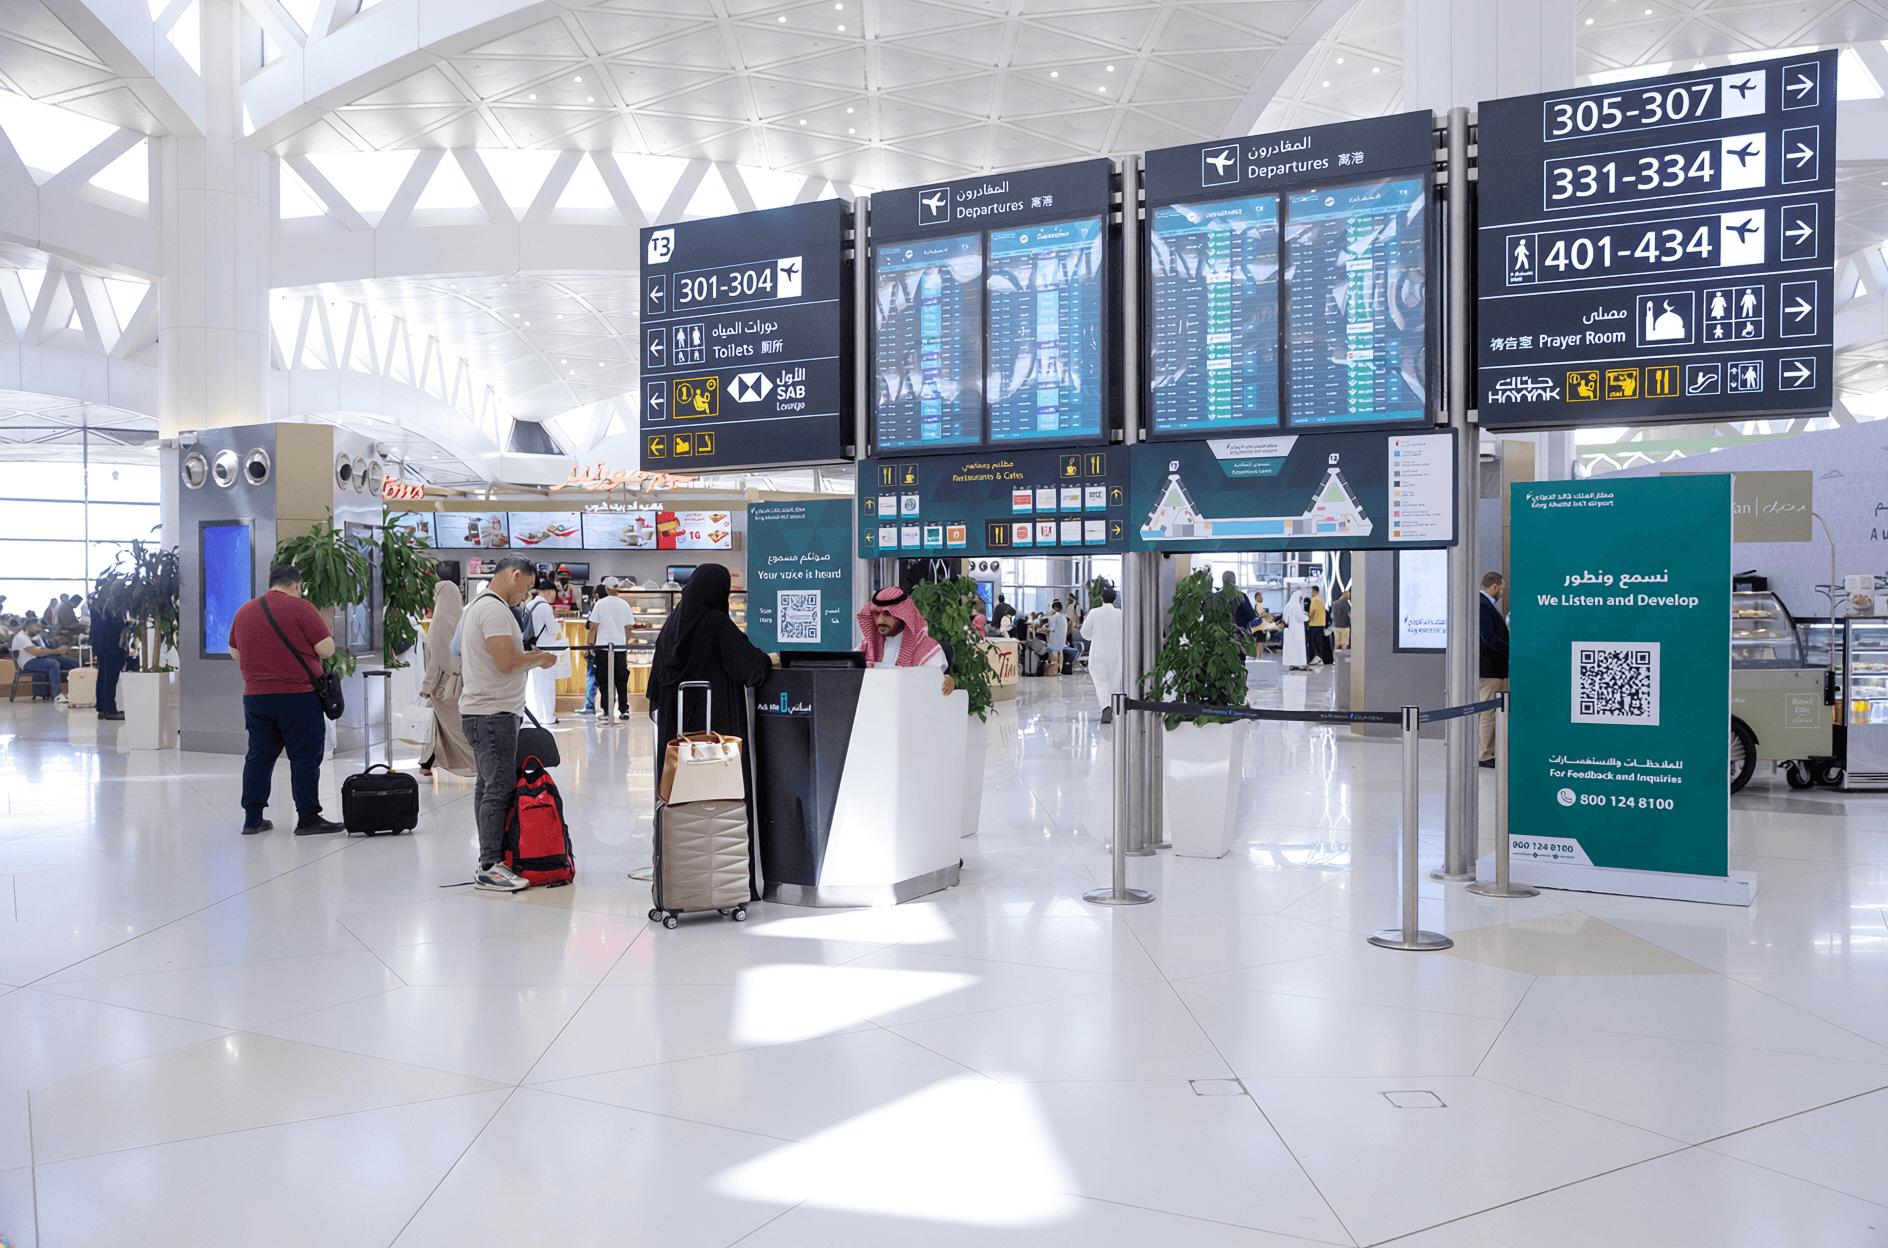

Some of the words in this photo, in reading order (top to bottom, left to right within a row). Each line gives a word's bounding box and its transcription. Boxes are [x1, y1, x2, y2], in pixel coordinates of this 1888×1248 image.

[1552, 84, 1713, 135] 305-307
[1248, 158, 1329, 178] Departures
[1551, 150, 1715, 200] 331-334
[956, 200, 1024, 219] Departures
[651, 236, 671, 257] T3
[1544, 226, 1713, 273] 401-434
[679, 268, 773, 303] 301-304
[1582, 306, 1628, 325] مصلى
[712, 321, 742, 339] المياه
[744, 319, 778, 335] دورات
[1539, 334, 1582, 350] Prayer
[1585, 331, 1626, 345] Room
[712, 343, 754, 359] Toilets
[776, 385, 806, 400] SAB
[1563, 569, 1614, 587] ونطور
[1619, 569, 1669, 589] نسمع
[1537, 594, 1559, 606] We
[1561, 594, 1604, 606] Listen
[1606, 594, 1634, 606] and
[1637, 594, 1699, 609] Develop
[1549, 769, 1566, 777] For
[1567, 769, 1614, 779] Feedback
[1615, 773, 1635, 781] and
[1636, 773, 1682, 784] Inquiries
[1580, 794, 1607, 806] 800
[1609, 796, 1635, 808] 124
[1637, 797, 1674, 810] 8100
